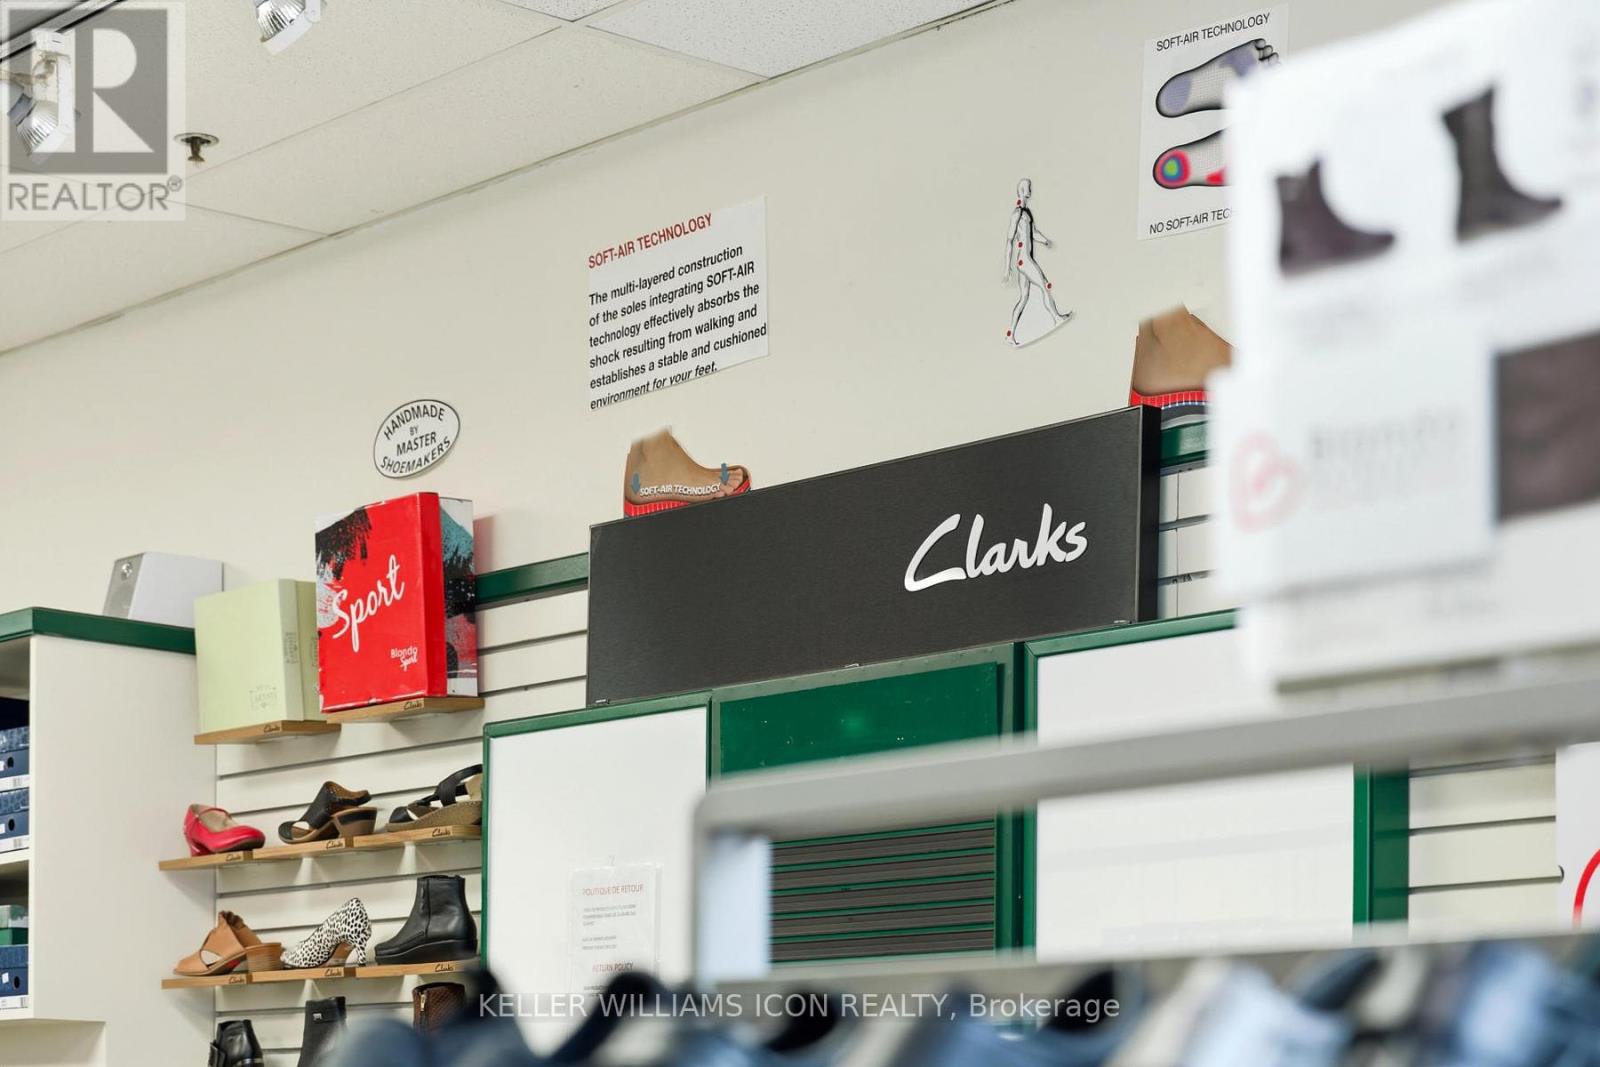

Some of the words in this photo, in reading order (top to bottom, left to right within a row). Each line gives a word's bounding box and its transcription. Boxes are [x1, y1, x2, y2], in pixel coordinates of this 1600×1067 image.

[1156, 31, 1199, 52] SOFT-AIR
[1201, 12, 1271, 40] TECHNOLOGY
[588, 241, 635, 269] SOFT-AIR
[637, 213, 712, 252] TECHNOLOGY
[1149, 221, 1165, 235] NO
[1166, 211, 1209, 231] SOFT-AIR
[589, 293, 608, 306] The
[611, 266, 675, 299] multi-layered
[678, 245, 743, 276] construction
[589, 312, 600, 327] of
[603, 309, 619, 324] the
[621, 298, 646, 317] soles
[649, 280, 704, 307] integrating
[706, 261, 755, 288] SOFT-AIR
[589, 322, 641, 348] technology
[643, 303, 695, 330] effectively
[697, 289, 740, 312] absorbs
[743, 282, 760, 299] the
[589, 349, 620, 368] shock
[622, 332, 665, 359] resulting
[668, 326, 692, 344] from
[695, 312, 735, 336] walking
[737, 304, 758, 322] and
[590, 362, 646, 389] establishes
[648, 360, 655, 371] a
[657, 348, 688, 369] stable
[691, 341, 711, 359] and
[713, 323, 767, 352] cushioned
[590, 381, 650, 410] environment
[652, 375, 666, 391] for
[669, 371, 693, 386] your
[694, 361, 718, 378] feet.
[384, 404, 445, 440] HANDMADE
[396, 431, 437, 456] MASTER
[409, 425, 419, 436] BY
[380, 435, 451, 474] SHOEMAKERS
[640, 484, 672, 496] SOFT-AIR
[673, 483, 721, 496] TECHNOLOGY
[904, 503, 1088, 592] Clarks
[332, 554, 405, 653] Sport
